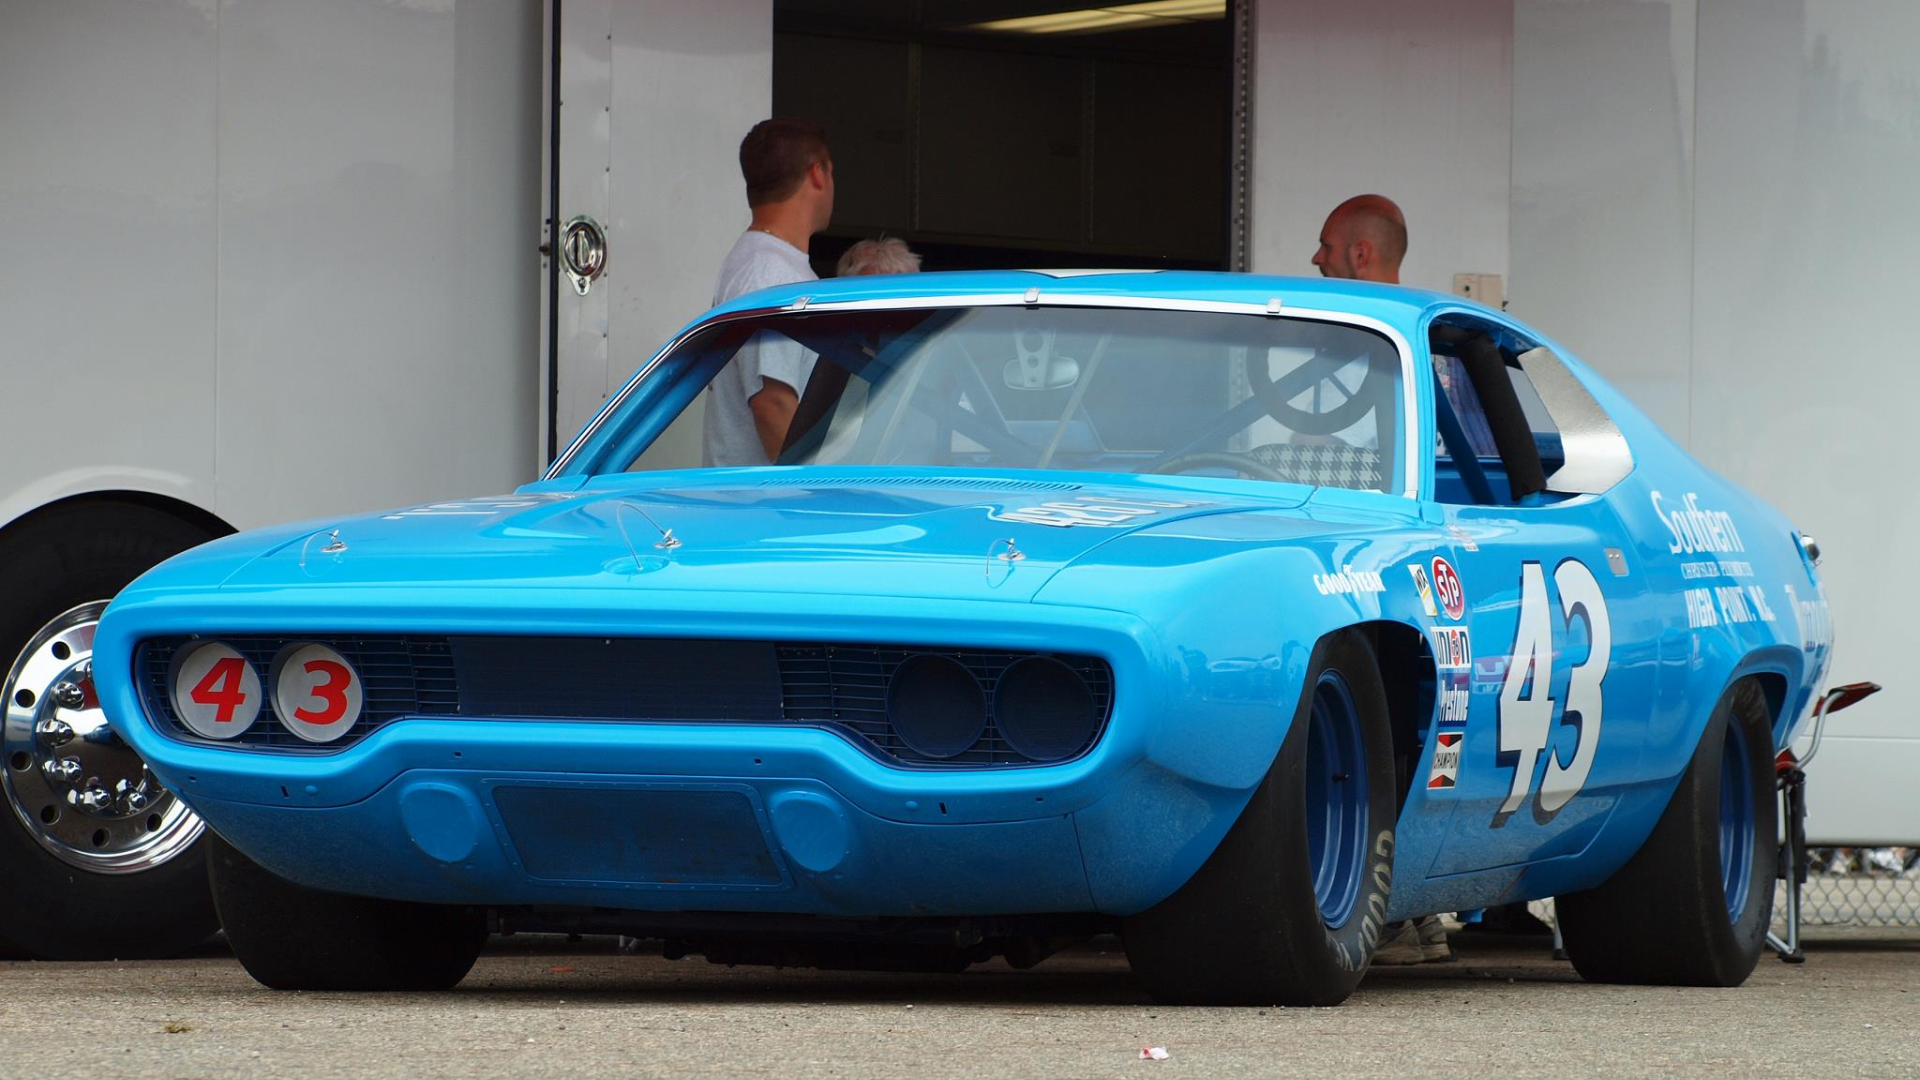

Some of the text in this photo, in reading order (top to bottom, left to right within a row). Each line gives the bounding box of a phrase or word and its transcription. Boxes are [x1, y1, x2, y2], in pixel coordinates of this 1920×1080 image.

[1650, 490, 1745, 555] Southern
[1437, 563, 1461, 608] STP
[1684, 587, 1718, 629] HIGH
[1491, 557, 1612, 828] 43
[1433, 751, 1460, 770] CHAMPION
